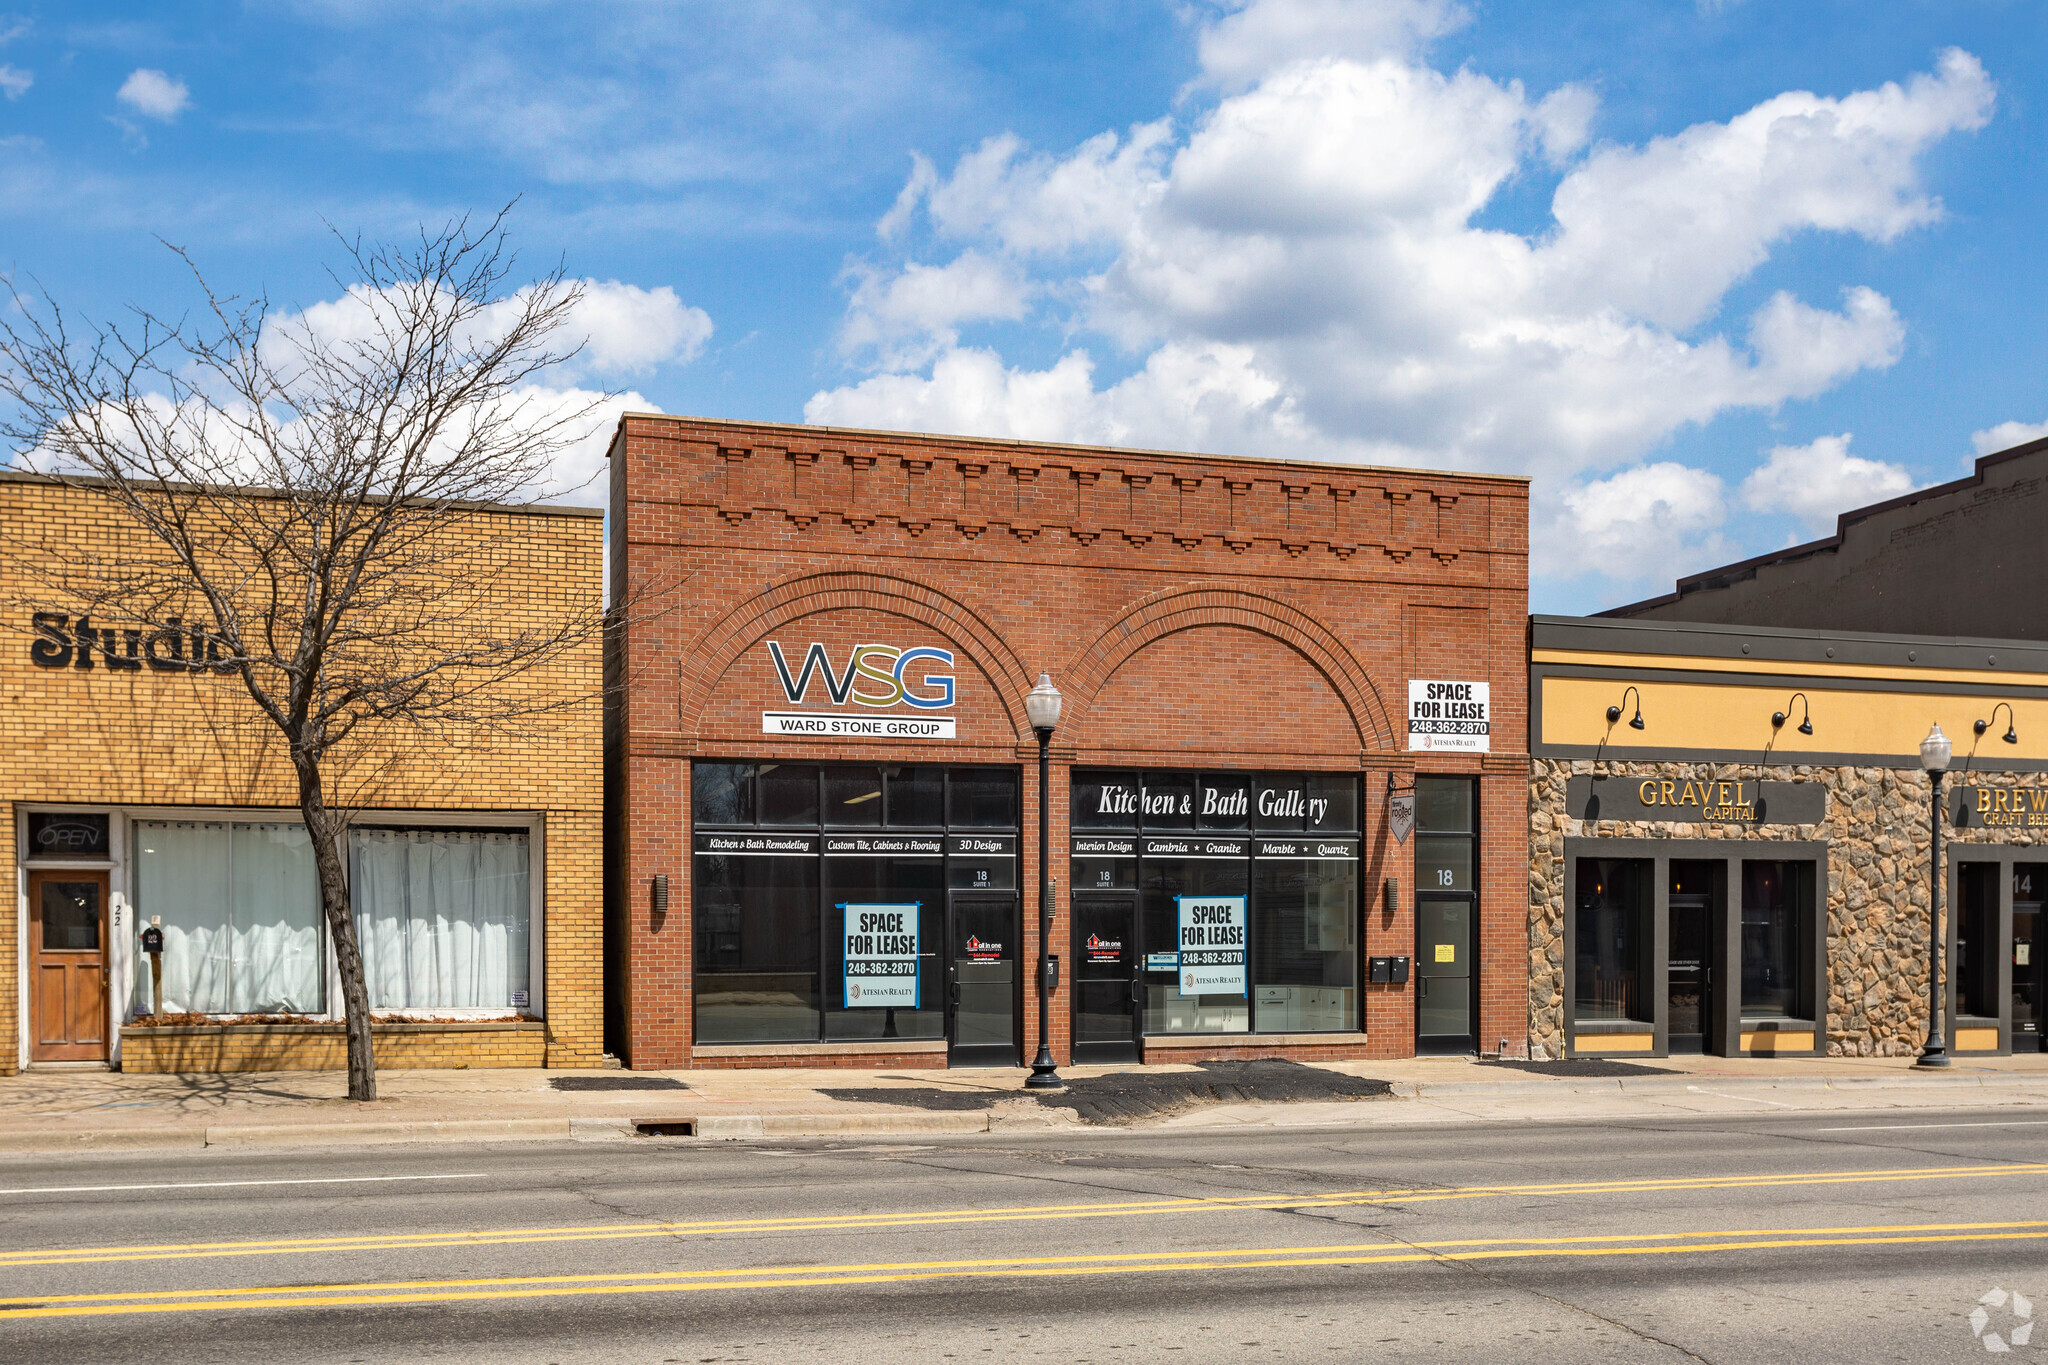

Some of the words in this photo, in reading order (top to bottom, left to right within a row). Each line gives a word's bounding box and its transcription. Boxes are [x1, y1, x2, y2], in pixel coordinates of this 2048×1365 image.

[766, 641, 955, 709] WSG
[1427, 683, 1472, 700] SPACE
[1414, 702, 1441, 718] FOR
[1445, 702, 1484, 719] LEASE
[780, 720, 826, 732] WARD
[831, 721, 882, 734] STONE
[886, 723, 940, 735] GROUP
[1411, 721, 1487, 734] 248-362-2870
[1456, 739, 1476, 747] REALTY
[1639, 780, 1751, 806] GRAVEL
[1097, 786, 1175, 814] Kitchen
[1180, 794, 1192, 814] &
[1201, 788, 1248, 816] Bath
[1258, 789, 1328, 824] Gallery
[1976, 789, 2048, 812] BREW
[1703, 807, 1758, 820] CAPITAL
[1983, 812, 2023, 826] CRAFT
[40, 828, 100, 845] OPEN
[710, 838, 738, 849] Kitchen
[740, 841, 745, 849] &
[746, 839, 764, 849] Bath
[766, 840, 809, 851] Remodeling
[828, 840, 854, 850] Custom
[856, 840, 871, 851] Tile,
[872, 840, 903, 850] Cabinets
[904, 842, 910, 850] &
[911, 841, 940, 852] Flooring
[959, 840, 972, 850] 3D
[974, 840, 1002, 852] Design
[1076, 841, 1105, 850] Interior
[1107, 842, 1132, 853] Design
[1148, 842, 1188, 852] Cambria
[1206, 843, 1241, 854] Granite
[1262, 844, 1296, 854] Marble
[1318, 844, 1349, 856] Quartz
[976, 871, 988, 880] 18
[1100, 871, 1110, 880] 18
[1437, 870, 1453, 886] 18
[2012, 874, 2032, 893] 14
[1192, 906, 1232, 924] SPACE
[860, 913, 904, 933] SPACE
[1182, 926, 1204, 945] FOR
[1208, 926, 1243, 945] LEASE
[848, 935, 873, 955] FOR
[877, 935, 915, 955] LEASE
[1182, 952, 1243, 964] 248-362-2870
[848, 962, 914, 974] 248-362-2870
[1220, 976, 1242, 984] REALTY
[862, 988, 888, 996] ATESIAN
[889, 988, 913, 996] REALTY
